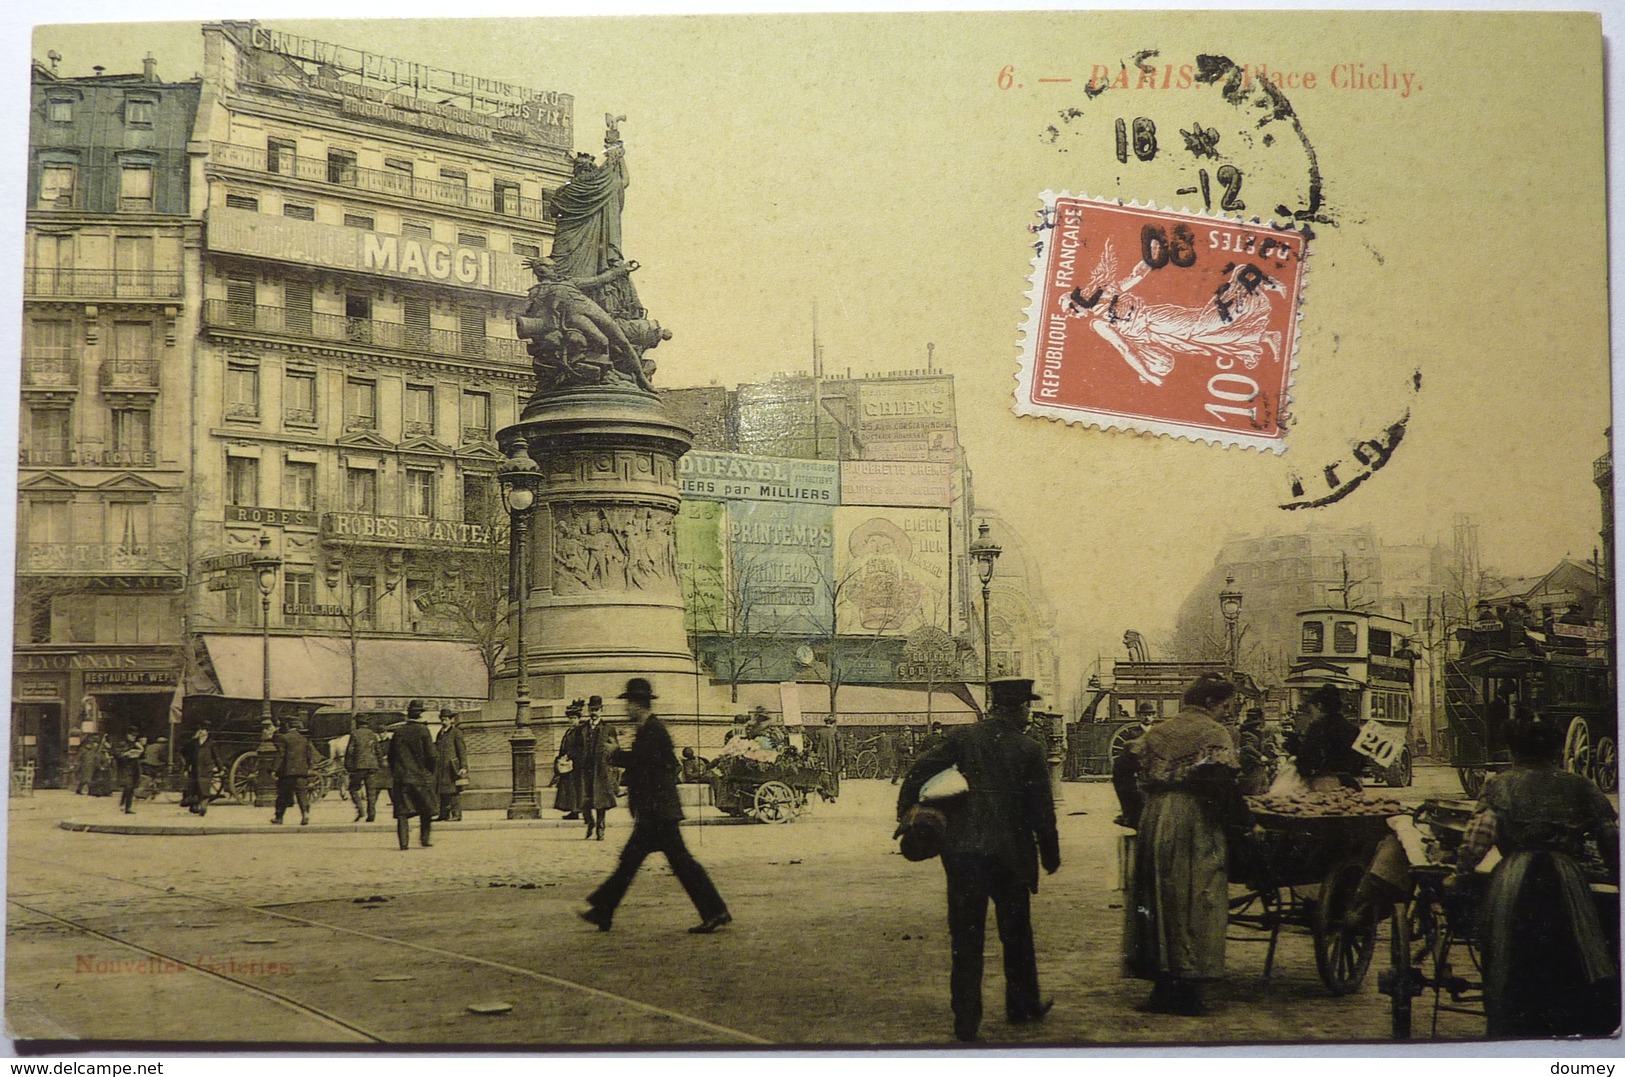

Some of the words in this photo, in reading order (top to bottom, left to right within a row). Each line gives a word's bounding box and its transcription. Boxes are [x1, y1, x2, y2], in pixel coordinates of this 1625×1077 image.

[997, 64, 1024, 91] 6.
[1330, 63, 1424, 99] Clichy.
[363, 233, 490, 286] MAGGI
[1055, 208, 1083, 290] FRANÇAISE
[1040, 313, 1067, 399] REPUBLIQUE
[864, 401, 945, 416] CHIENS
[679, 455, 788, 482] DUFAYEL
[724, 485, 751, 496] par
[760, 485, 831, 501] MILLIERS
[238, 509, 304, 525] ROBES
[336, 515, 399, 537] ROBES
[730, 521, 833, 548] PRINTEMPS
[286, 604, 316, 614] GRILL
[26, 654, 137, 669] LYONNAIS
[85, 672, 145, 683] RESTAURANT
[1360, 732, 1394, 760] 20
[75, 954, 187, 975] Nouvelles
